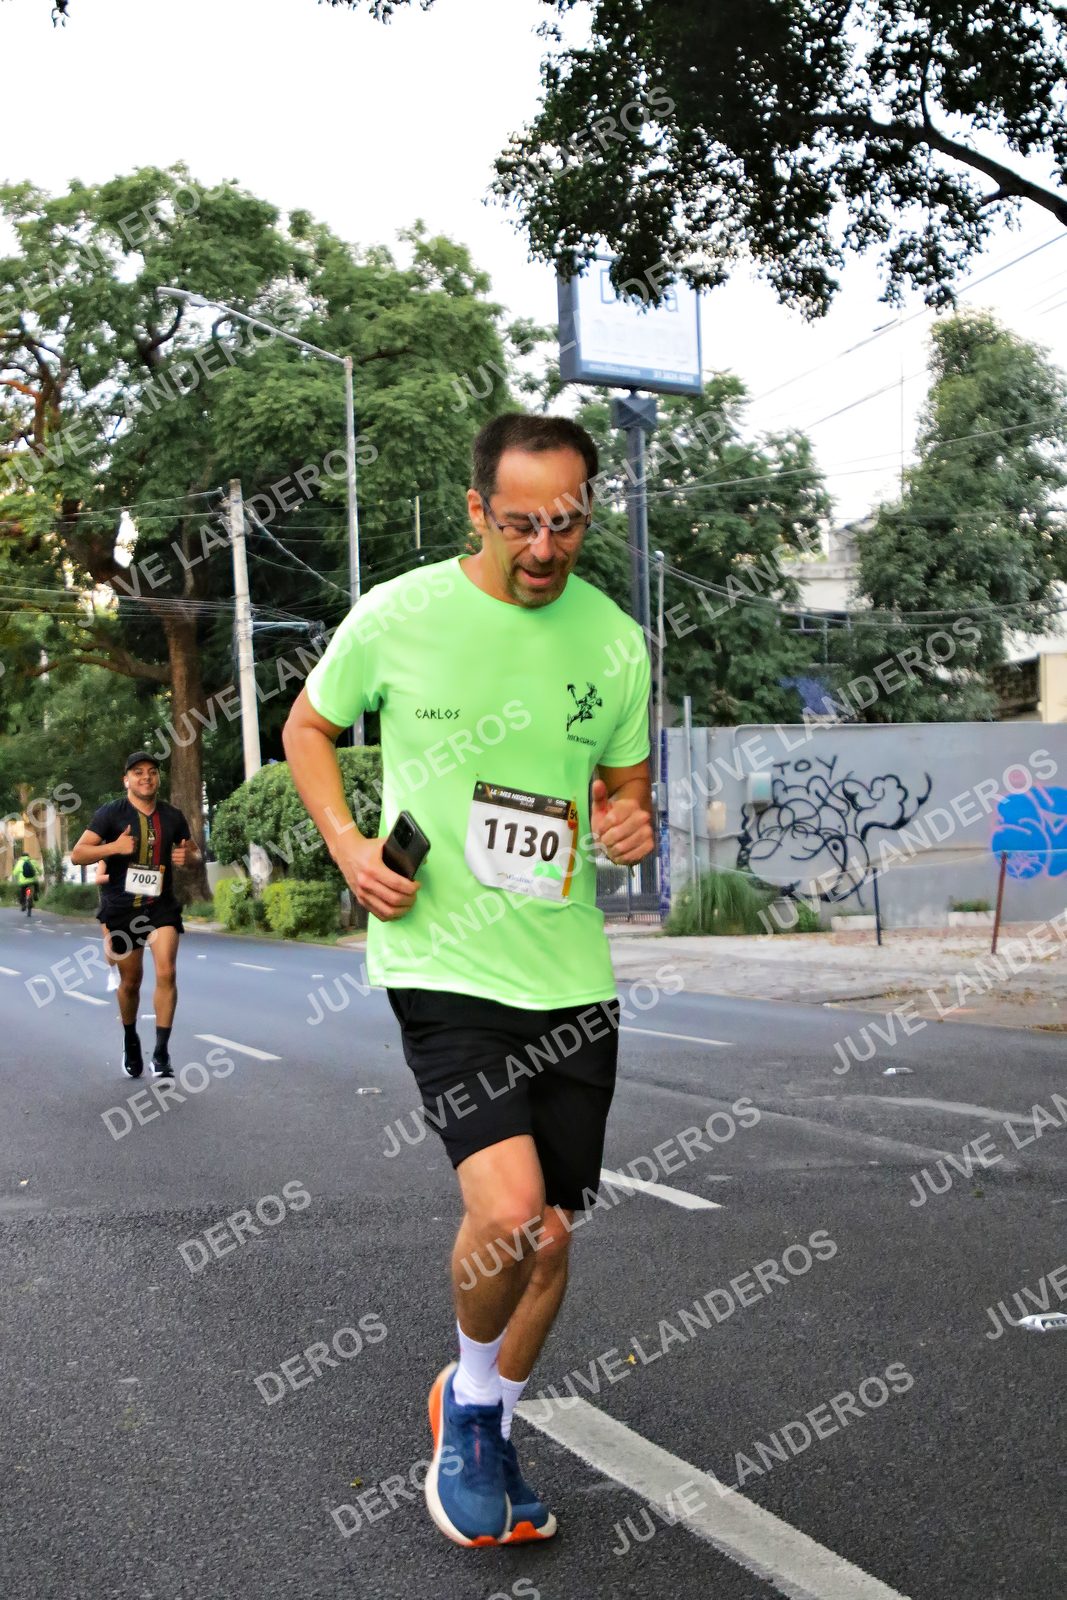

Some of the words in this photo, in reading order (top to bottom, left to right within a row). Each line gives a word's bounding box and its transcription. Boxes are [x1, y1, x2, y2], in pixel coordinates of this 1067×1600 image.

[415, 708, 461, 720] CARLOS
[773, 755, 838, 779] TOY
[485, 818, 560, 862] 1130
[132, 873, 157, 885] 7002
